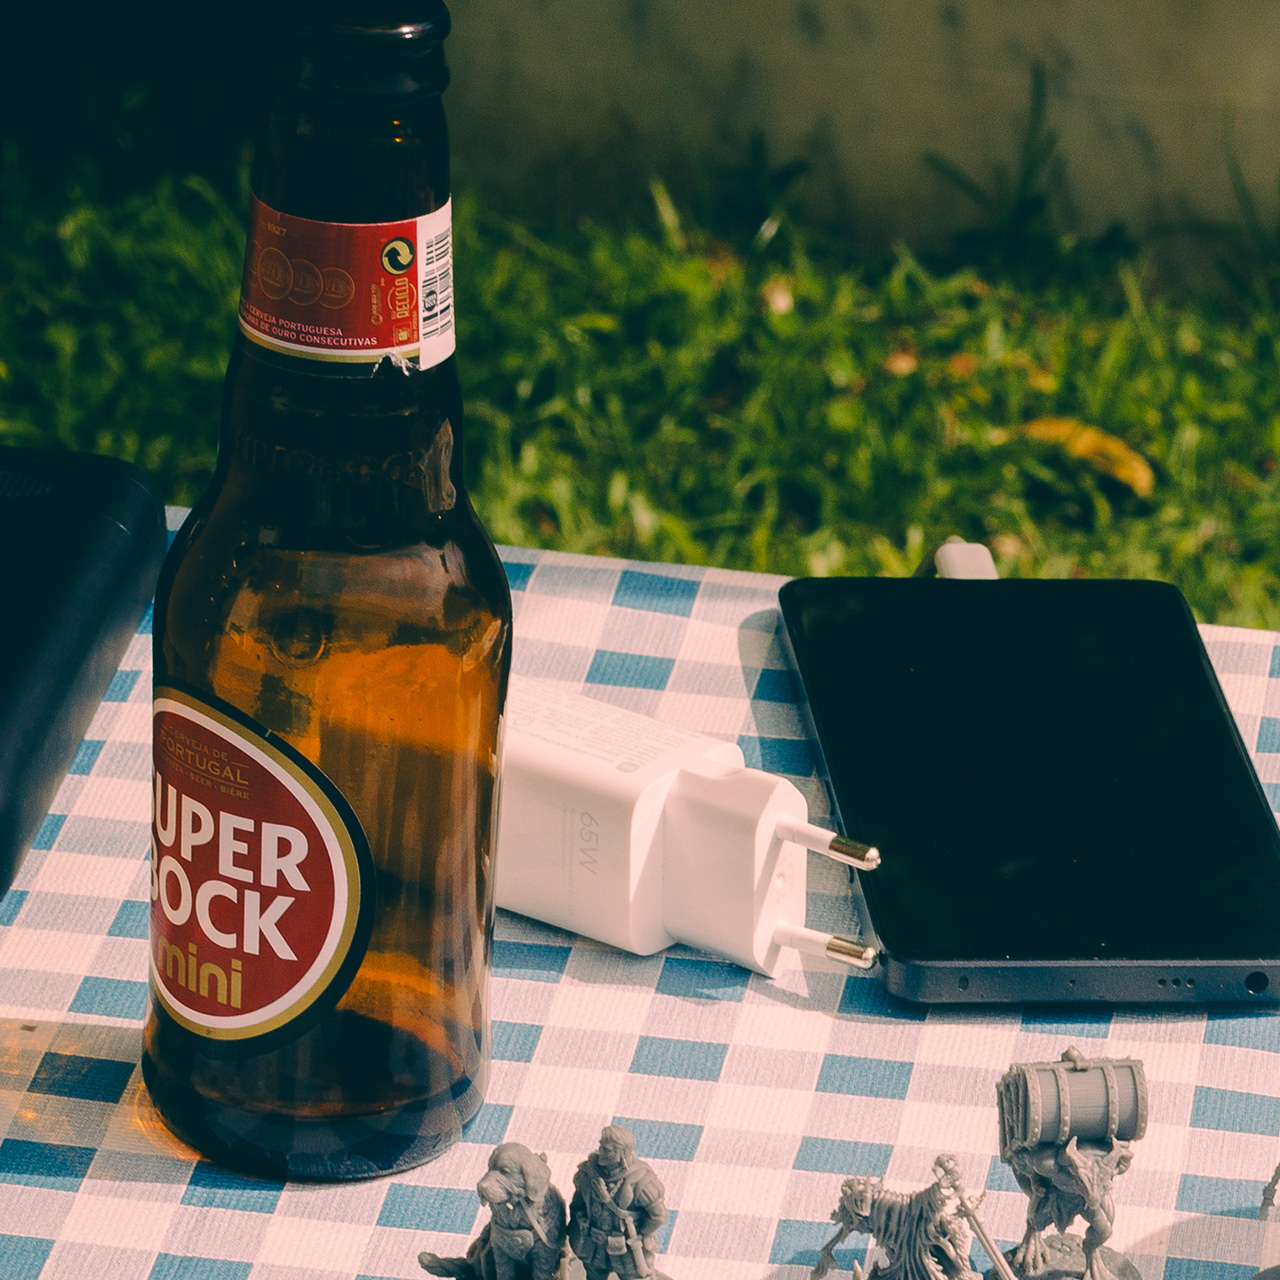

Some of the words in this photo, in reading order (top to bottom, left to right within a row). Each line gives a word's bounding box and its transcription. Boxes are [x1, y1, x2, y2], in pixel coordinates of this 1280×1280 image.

[394, 277, 410, 320] RECICLO
[249, 304, 276, 324] CERVEJA
[278, 318, 343, 337] PORTUGUESA
[260, 320, 271, 332] DE
[271, 326, 297, 340] OURO
[299, 333, 378, 347] CONSECUTIVAS
[212, 748, 228, 762] DE
[152, 769, 312, 892] UPER
[579, 811, 600, 877] 65W
[157, 935, 243, 1010] mini
